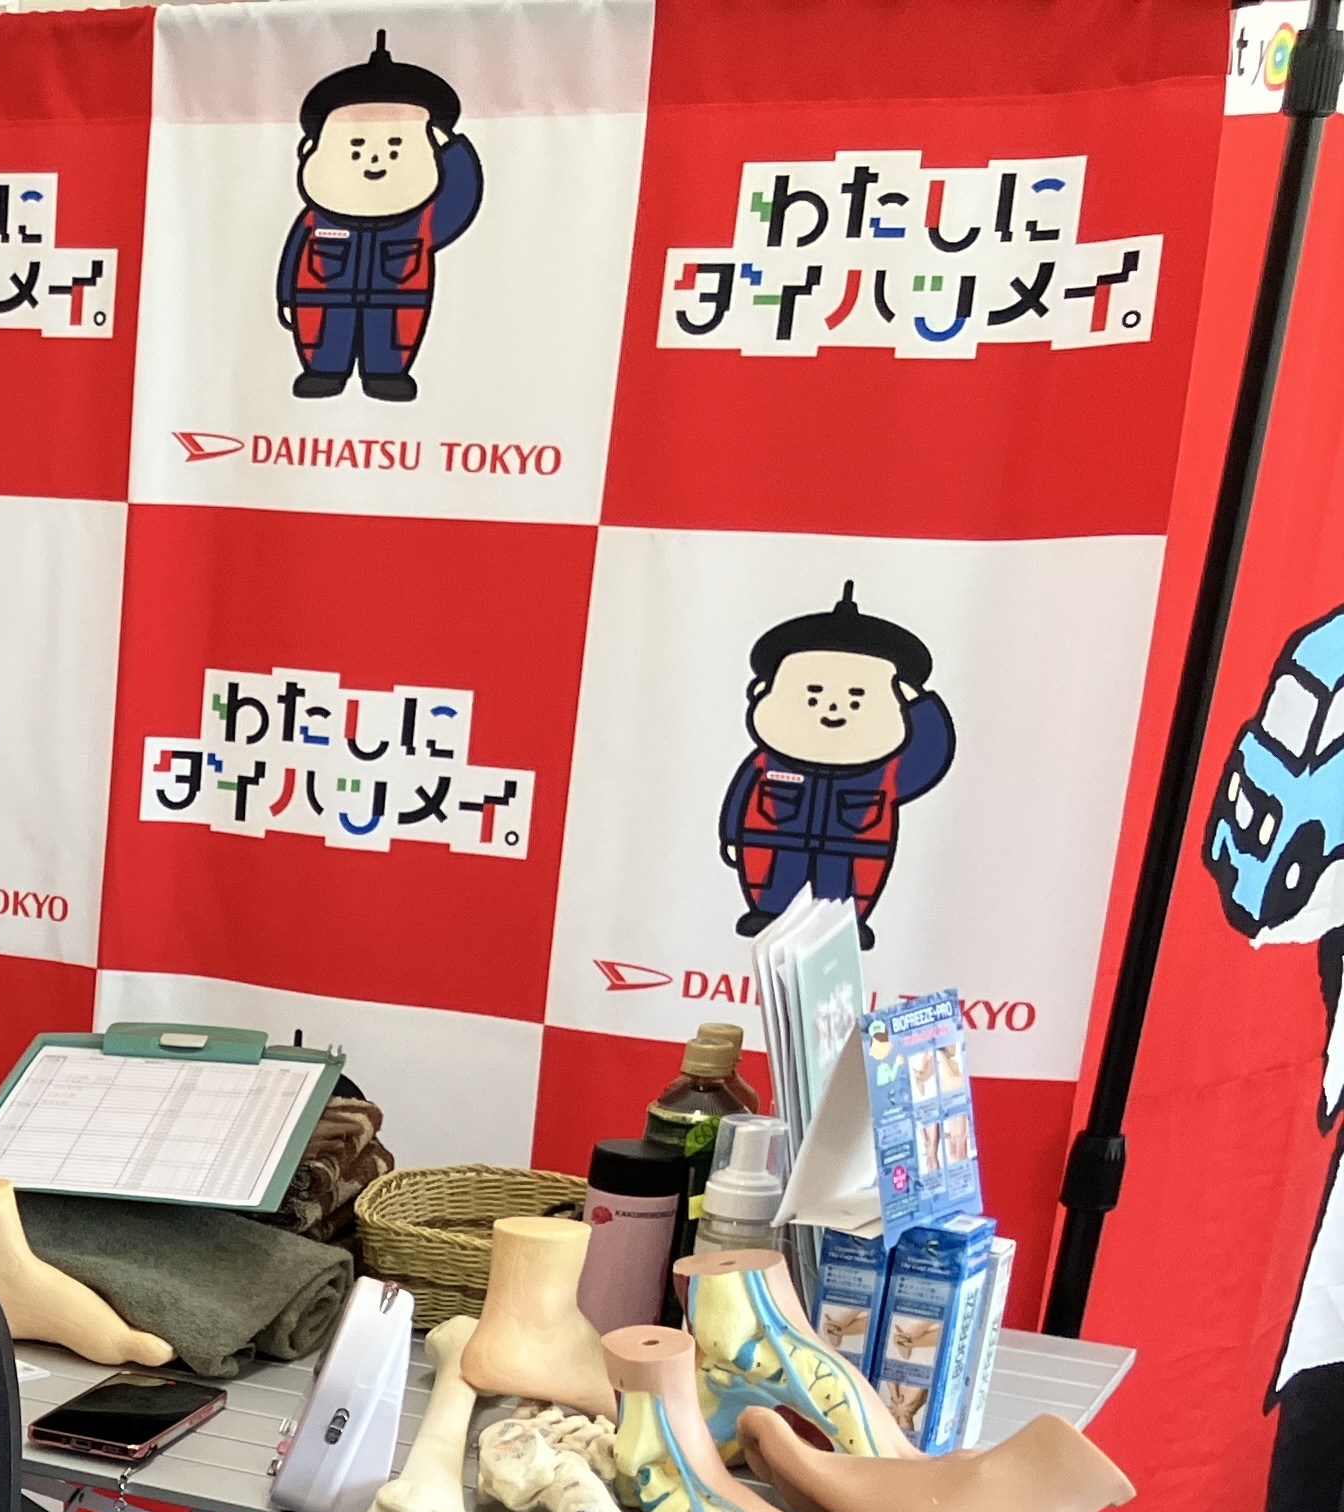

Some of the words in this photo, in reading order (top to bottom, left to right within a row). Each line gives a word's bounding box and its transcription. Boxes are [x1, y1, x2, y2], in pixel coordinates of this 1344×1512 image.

[749, 166, 1066, 254] わたしに
[674, 255, 1141, 342] ダイハツメイ。
[251, 432, 422, 474] DAIHATSU
[440, 441, 562, 478] TOKYO
[212, 681, 459, 762] わたしに
[153, 750, 521, 848] ダイハツメイ。
